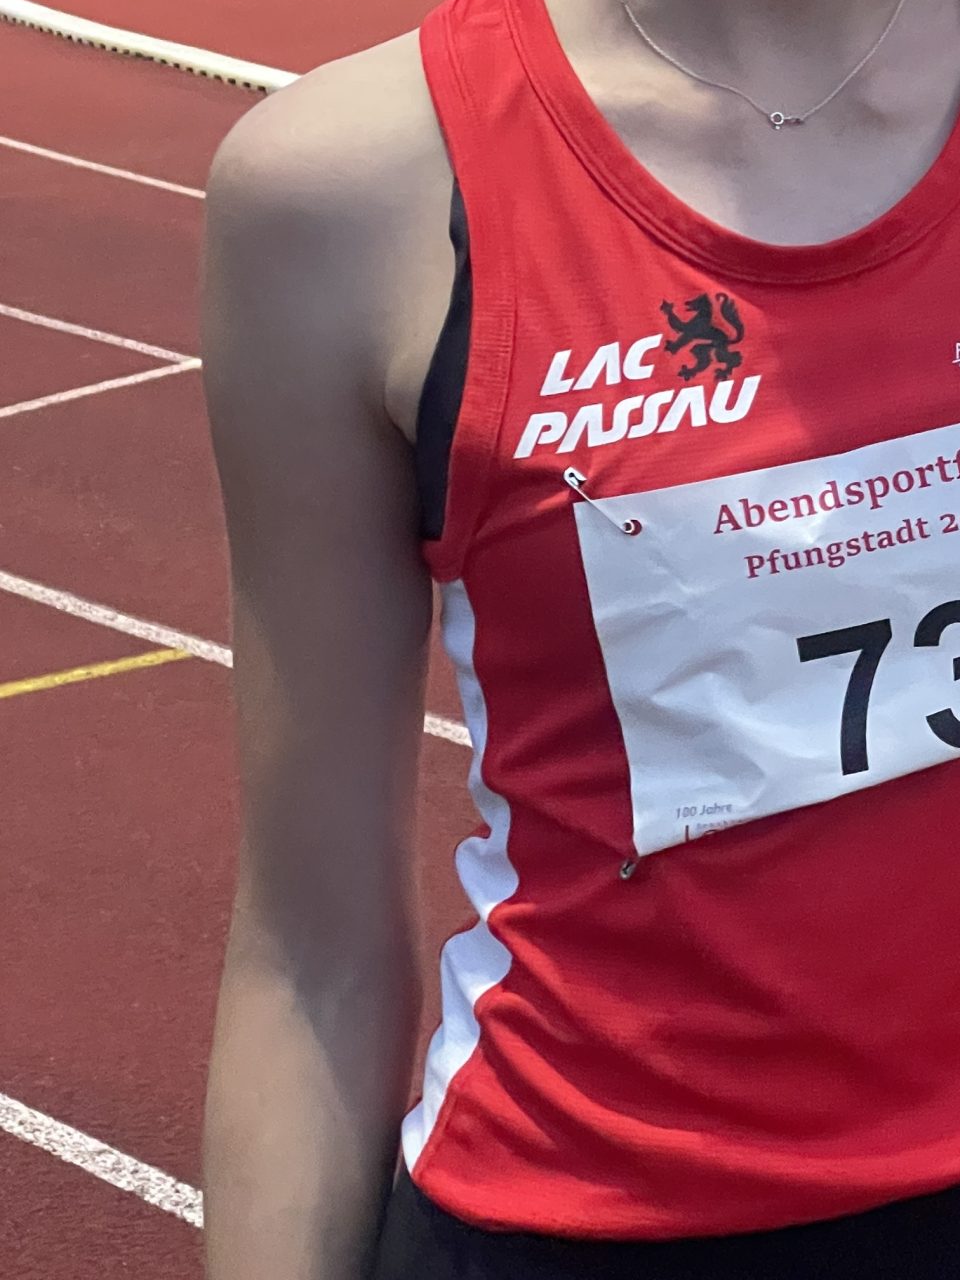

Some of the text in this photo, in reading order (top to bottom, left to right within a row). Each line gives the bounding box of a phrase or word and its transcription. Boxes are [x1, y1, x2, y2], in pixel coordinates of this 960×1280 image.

[540, 334, 663, 396] LAC
[513, 375, 762, 459] PASSAU
[744, 517, 931, 579] Pfungstadt
[676, 803, 732, 819] 100 Jahre
